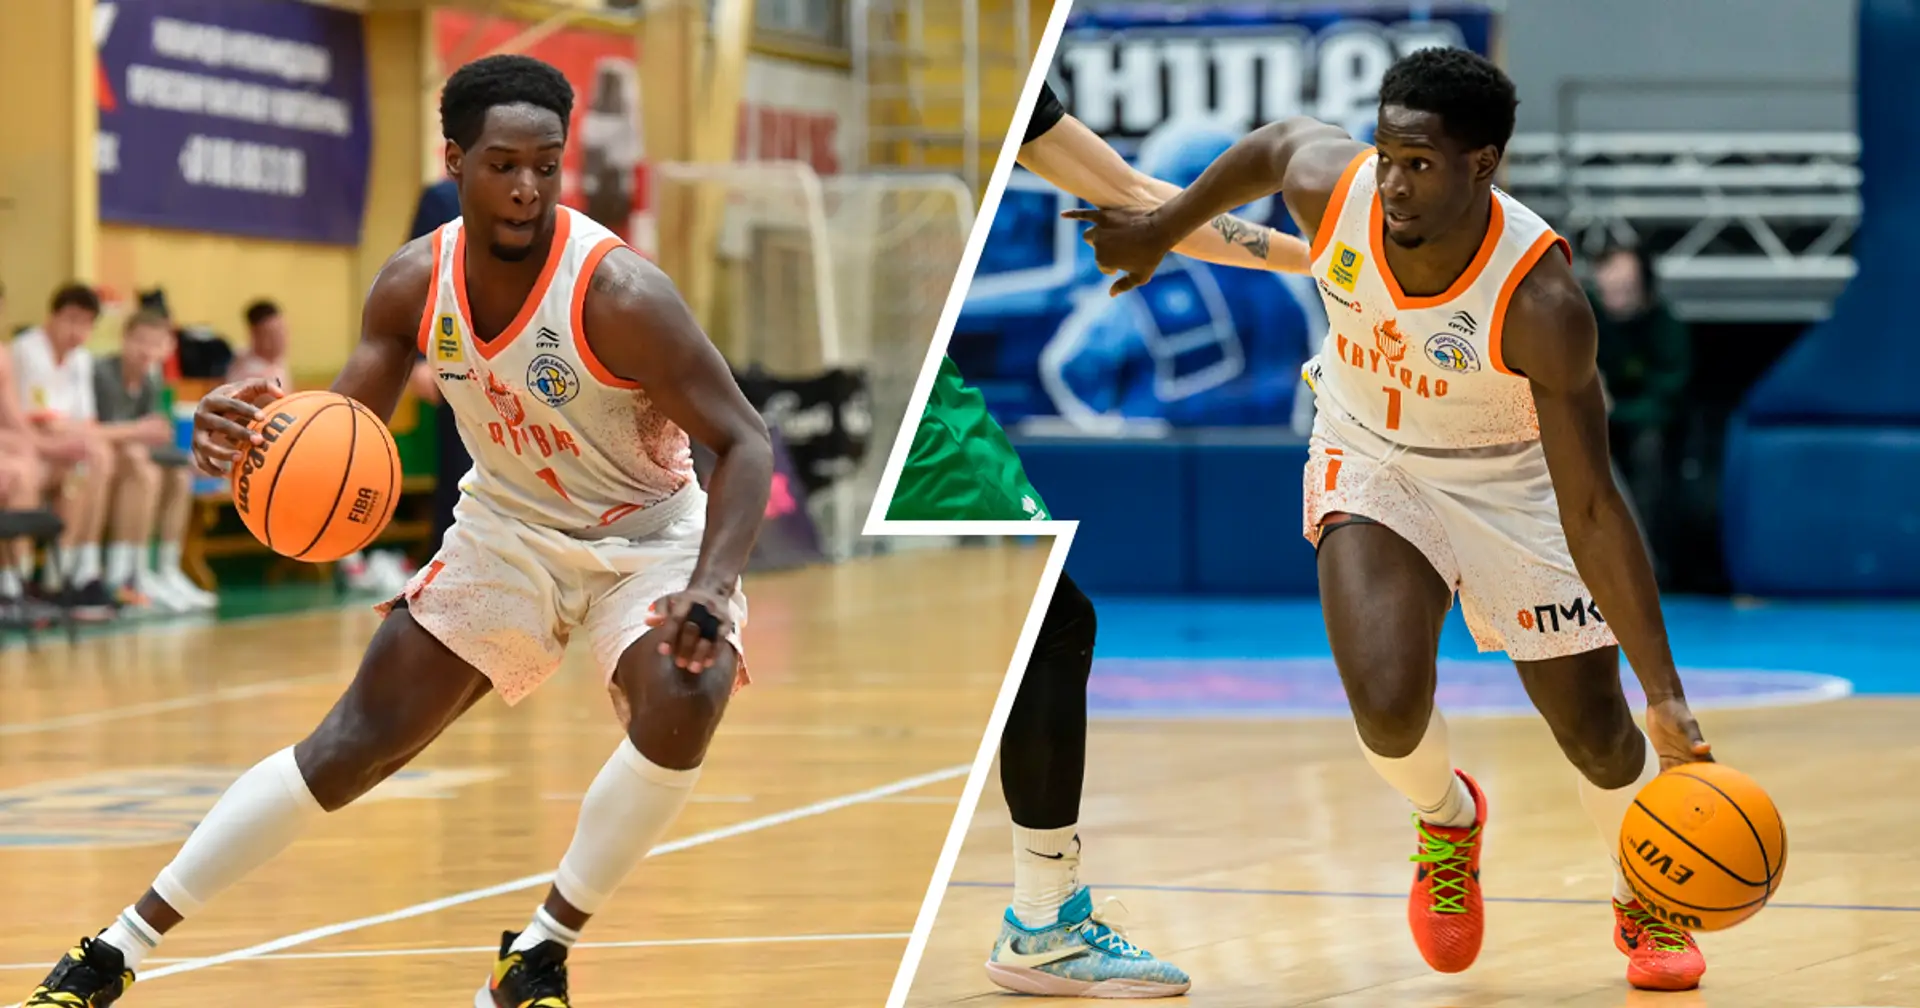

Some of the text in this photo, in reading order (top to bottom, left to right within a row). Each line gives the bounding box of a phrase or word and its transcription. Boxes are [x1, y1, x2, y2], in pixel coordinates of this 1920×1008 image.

[1382, 386, 1401, 430] 1
[347, 488, 372, 522] FIBA
[1637, 839, 1694, 886] EVO
